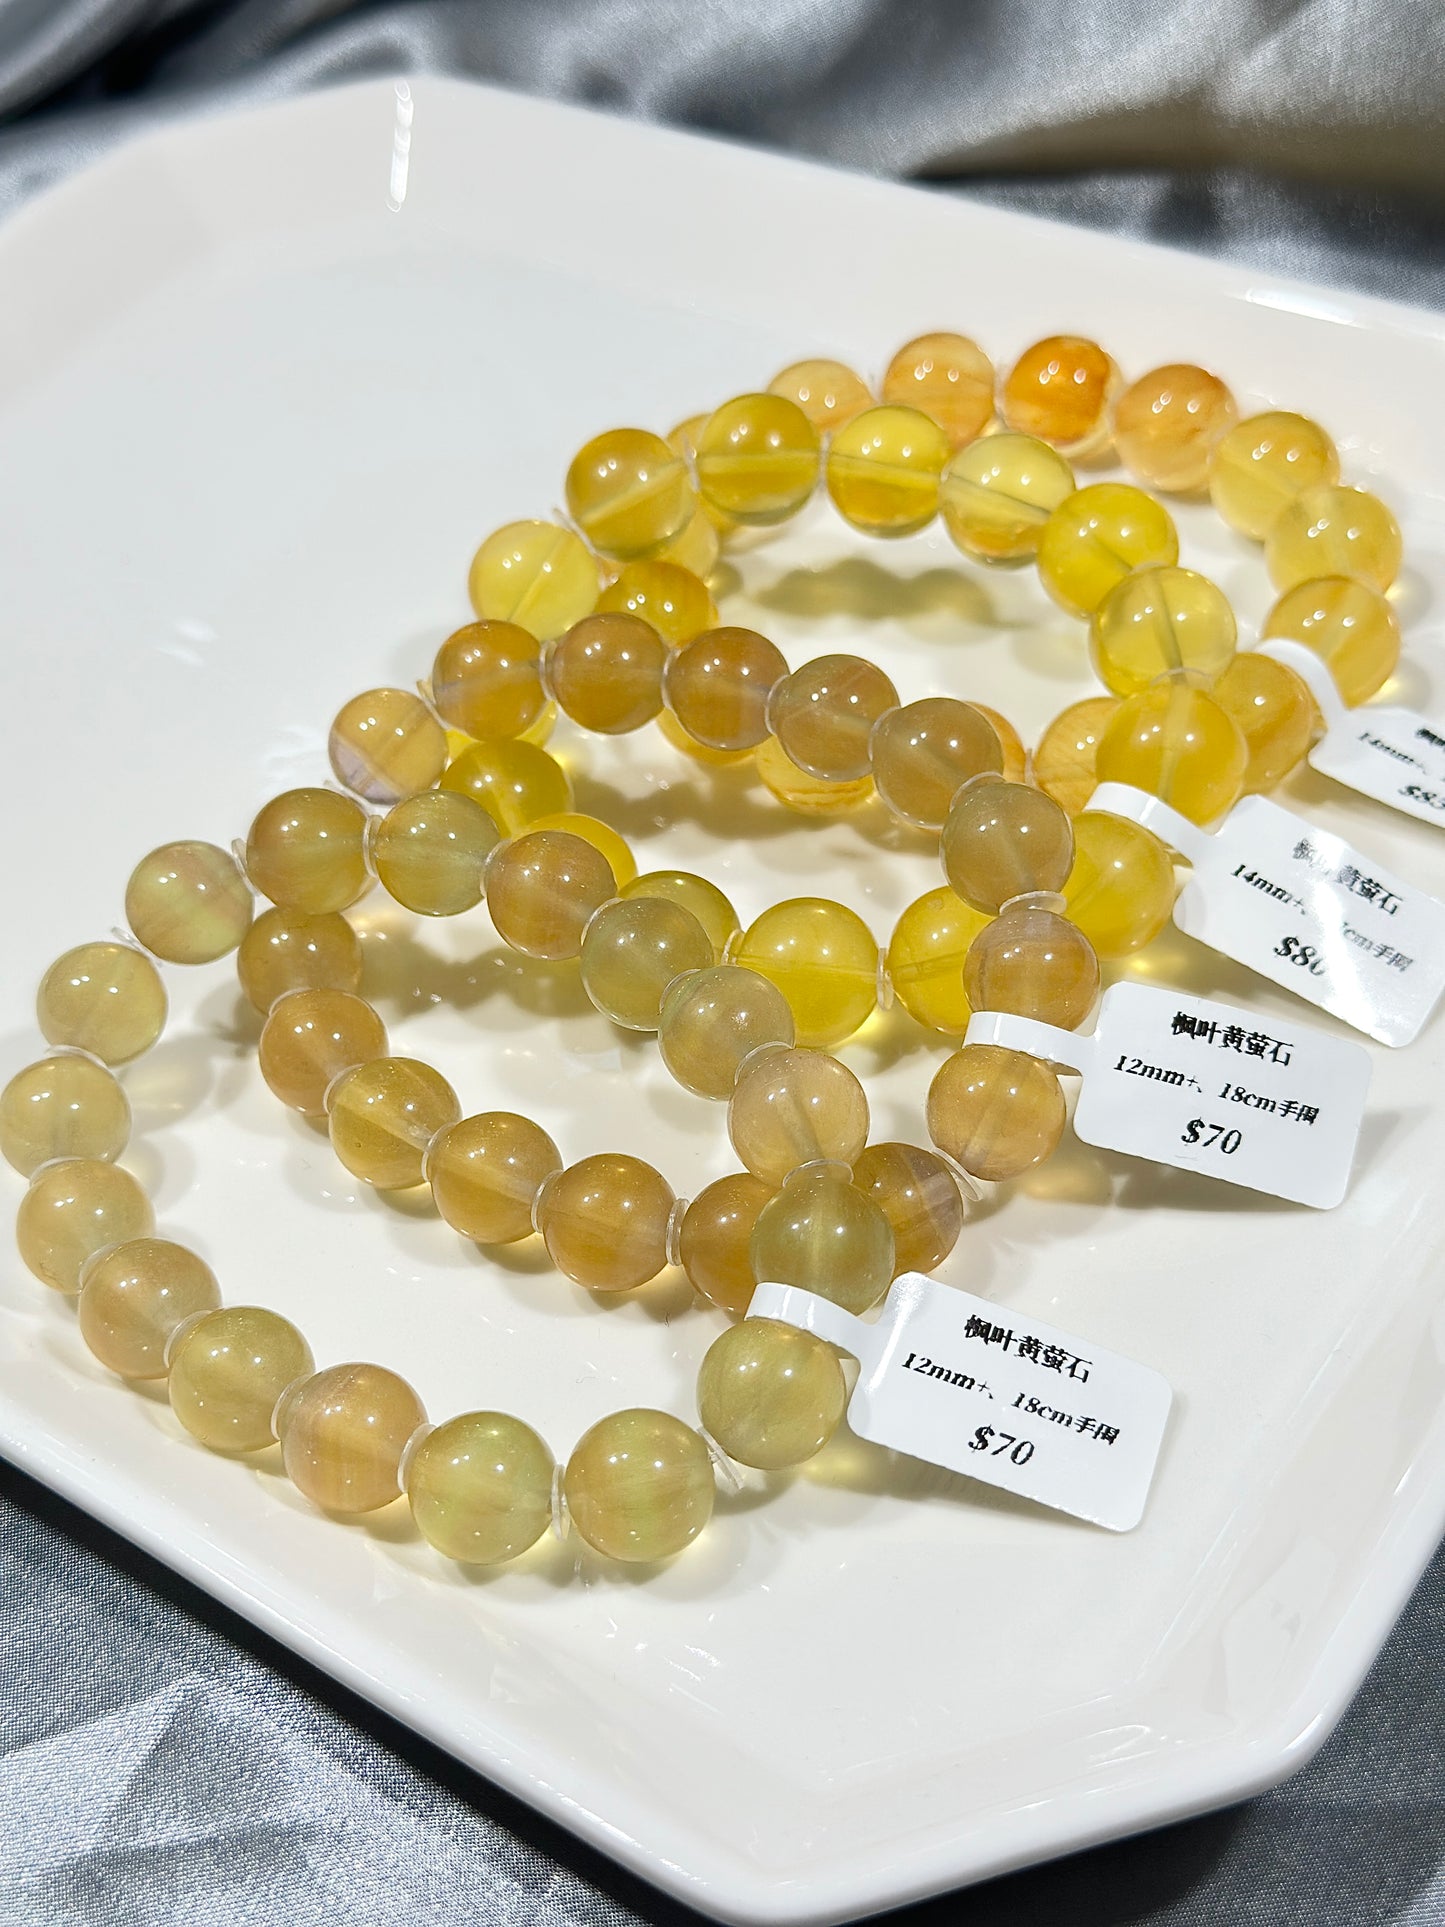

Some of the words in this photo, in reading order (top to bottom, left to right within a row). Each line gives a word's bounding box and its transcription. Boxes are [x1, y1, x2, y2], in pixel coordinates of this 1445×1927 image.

[1170, 1011, 1294, 1067] 枫叶黄萤石
[1181, 1117, 1243, 1155] $70
[963, 1314, 1094, 1384] 枫叶黄萤石
[968, 1424, 1036, 1466] $70
